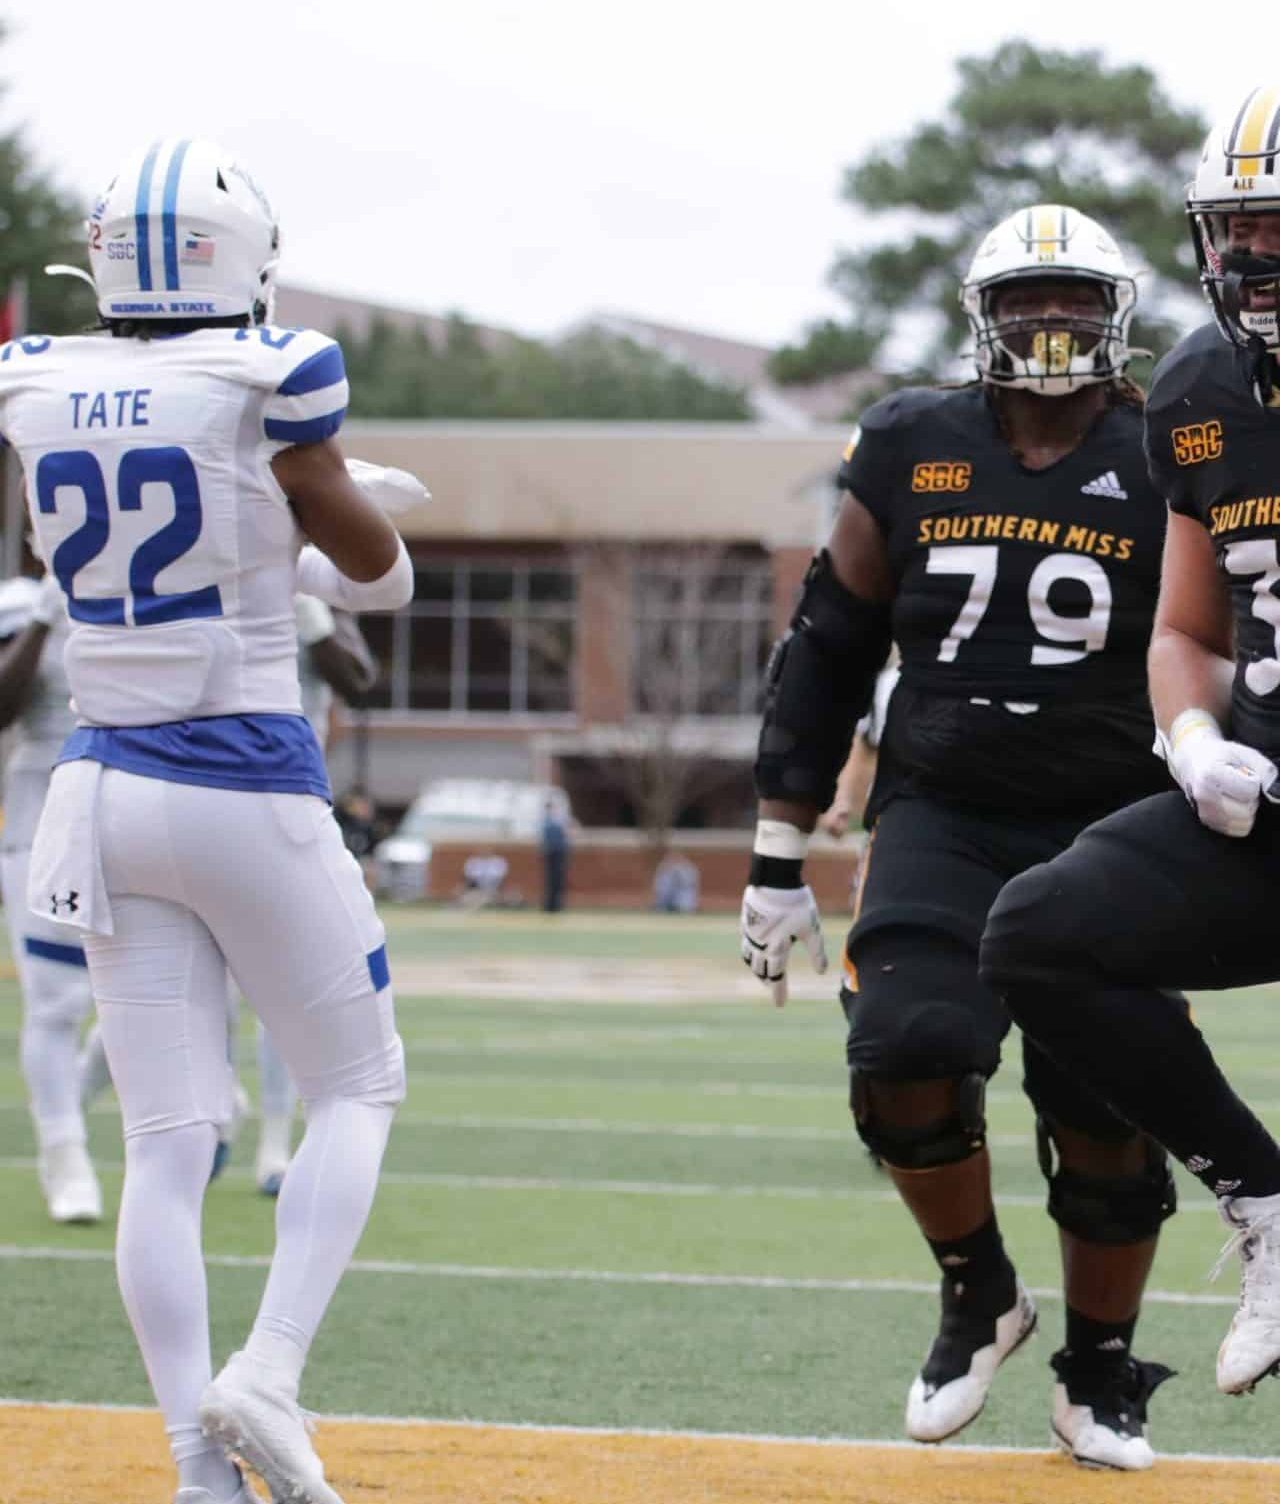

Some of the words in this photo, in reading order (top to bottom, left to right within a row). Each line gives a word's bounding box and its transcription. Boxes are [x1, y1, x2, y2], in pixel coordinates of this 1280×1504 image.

[107, 242, 136, 260] SBC
[170, 302, 216, 313] STATE
[70, 389, 152, 428] TATE
[1172, 421, 1223, 466] SBC
[912, 463, 972, 492] SBC
[36, 446, 222, 626] 22
[917, 515, 1057, 543] SOUTHERN
[1063, 526, 1135, 560] MISS
[925, 546, 1112, 665] 79
